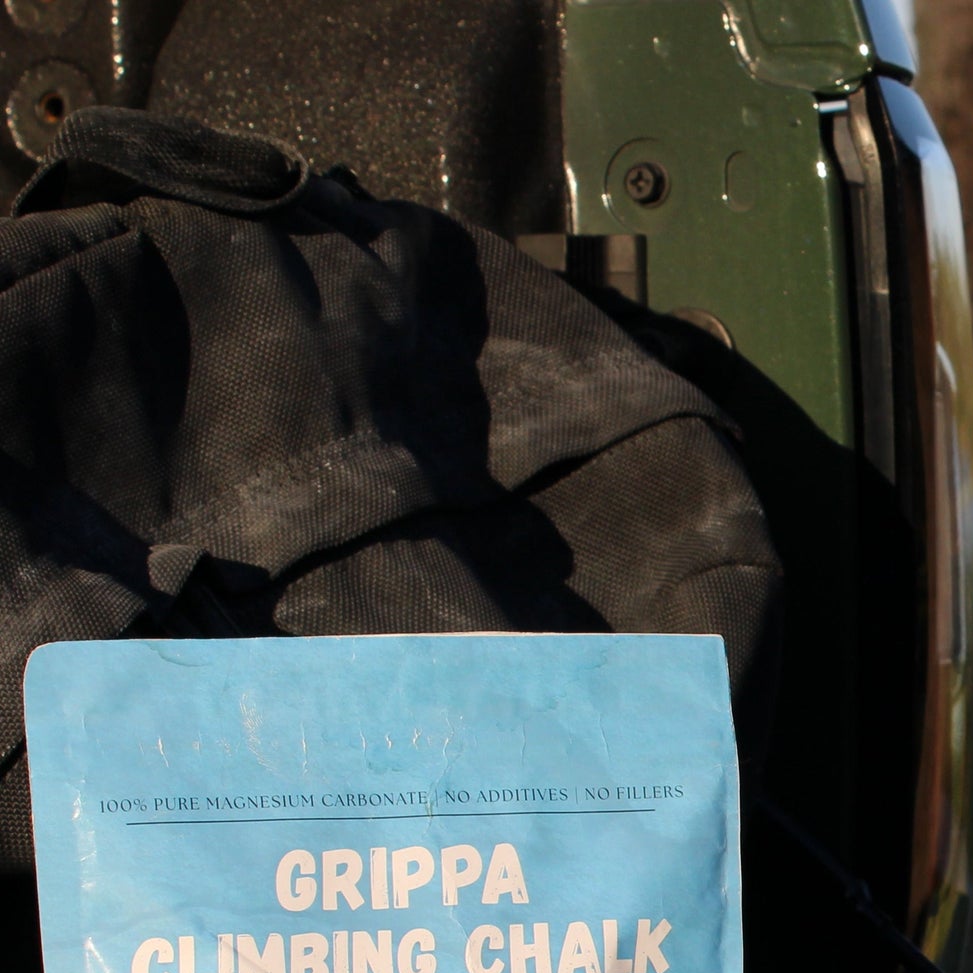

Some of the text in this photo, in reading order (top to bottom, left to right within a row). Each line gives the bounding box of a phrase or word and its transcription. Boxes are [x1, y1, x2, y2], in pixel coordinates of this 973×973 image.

[99, 785, 684, 813] 100% PURE MAGNESIUM CARBONATE NO ADDITIVES NO FILLERS
[275, 842, 529, 912] GRIPPA
